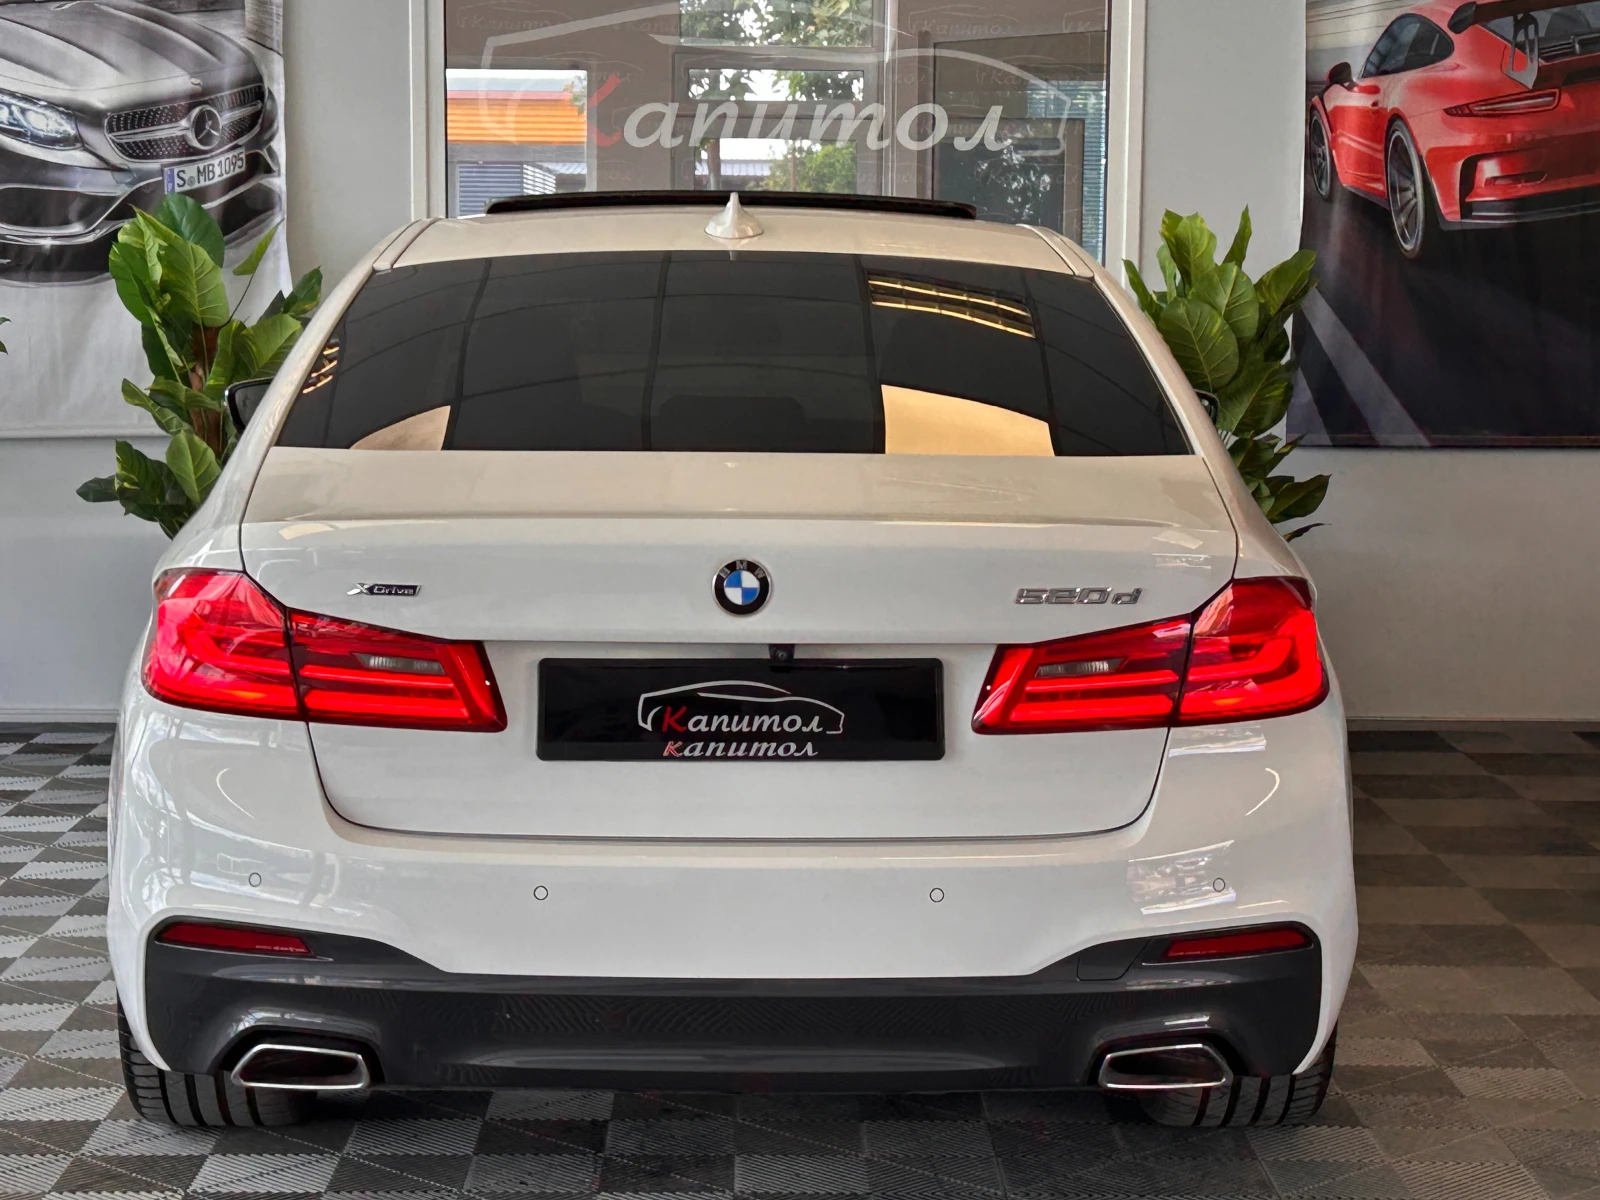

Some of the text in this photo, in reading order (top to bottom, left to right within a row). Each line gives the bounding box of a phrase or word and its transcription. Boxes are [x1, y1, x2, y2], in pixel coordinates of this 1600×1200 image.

[176, 151, 245, 188] S MB 1095
[718, 560, 767, 579] BMW
[661, 705, 824, 733] Капитол
